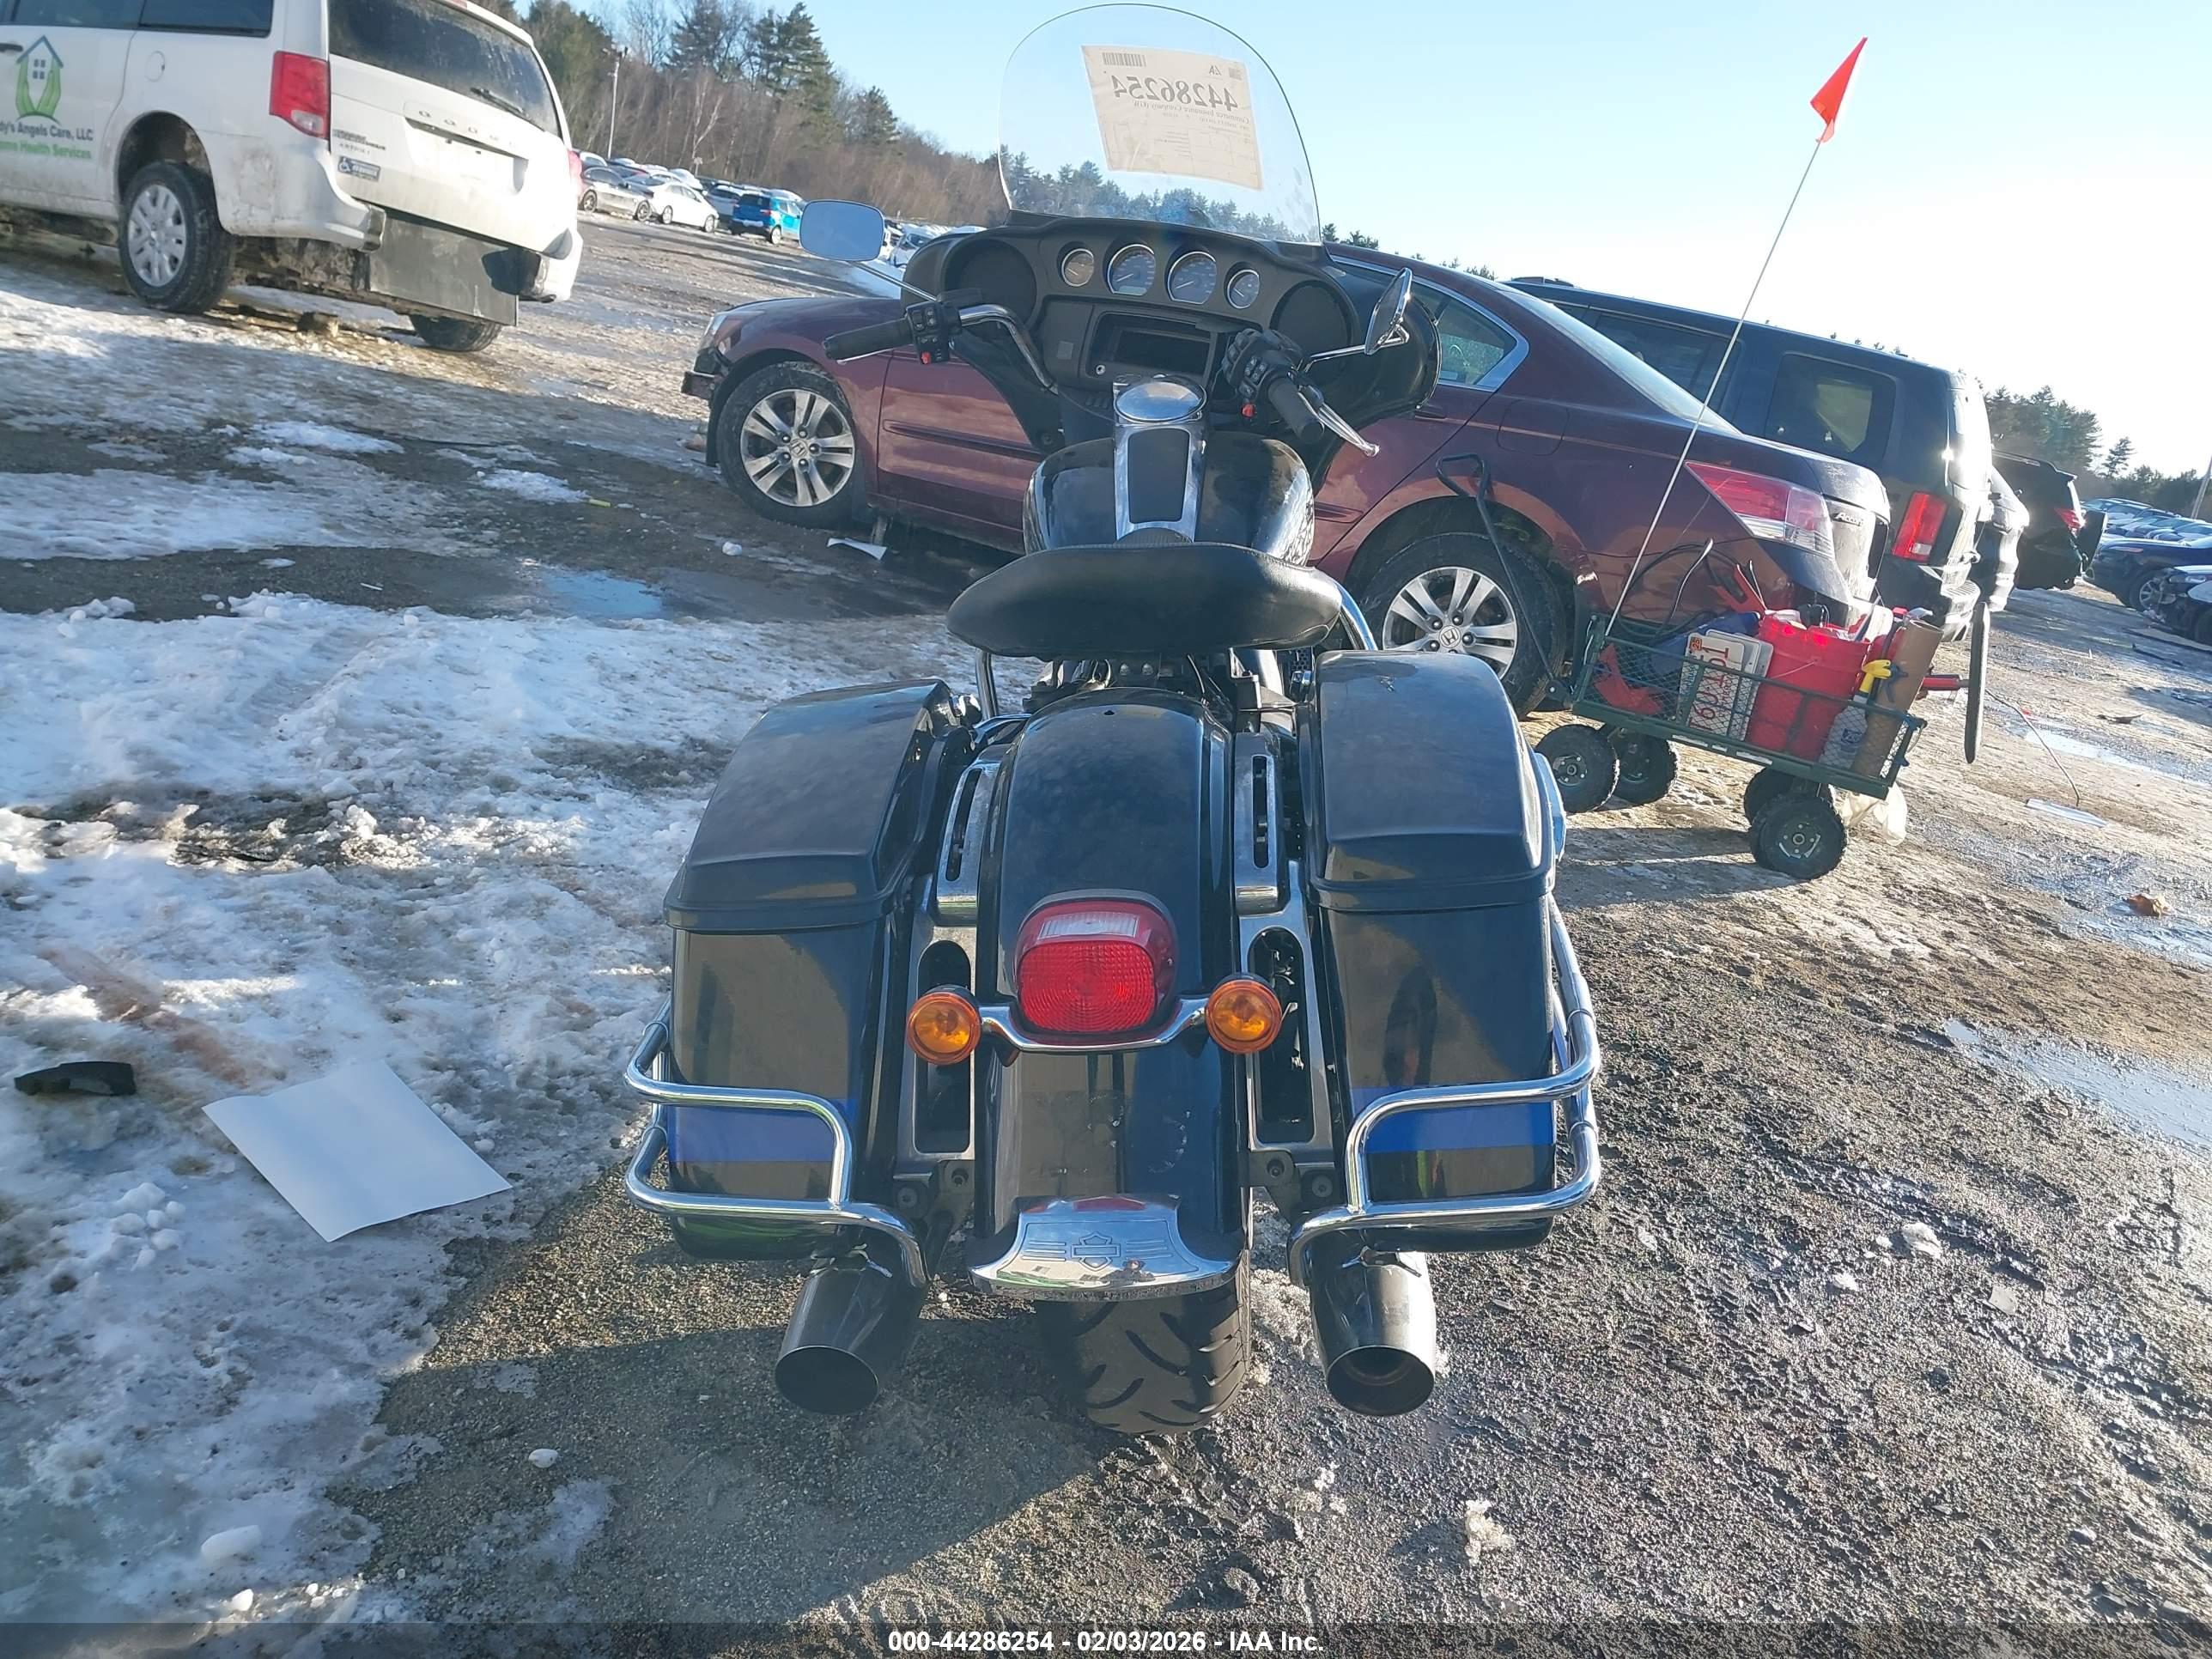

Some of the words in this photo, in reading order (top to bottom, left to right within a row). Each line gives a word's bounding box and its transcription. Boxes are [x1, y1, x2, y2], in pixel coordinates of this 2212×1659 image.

[17, 122, 48, 138] Angels
[50, 125, 75, 141] Care,
[76, 128, 94, 142] LLC
[52, 143, 92, 160] Services
